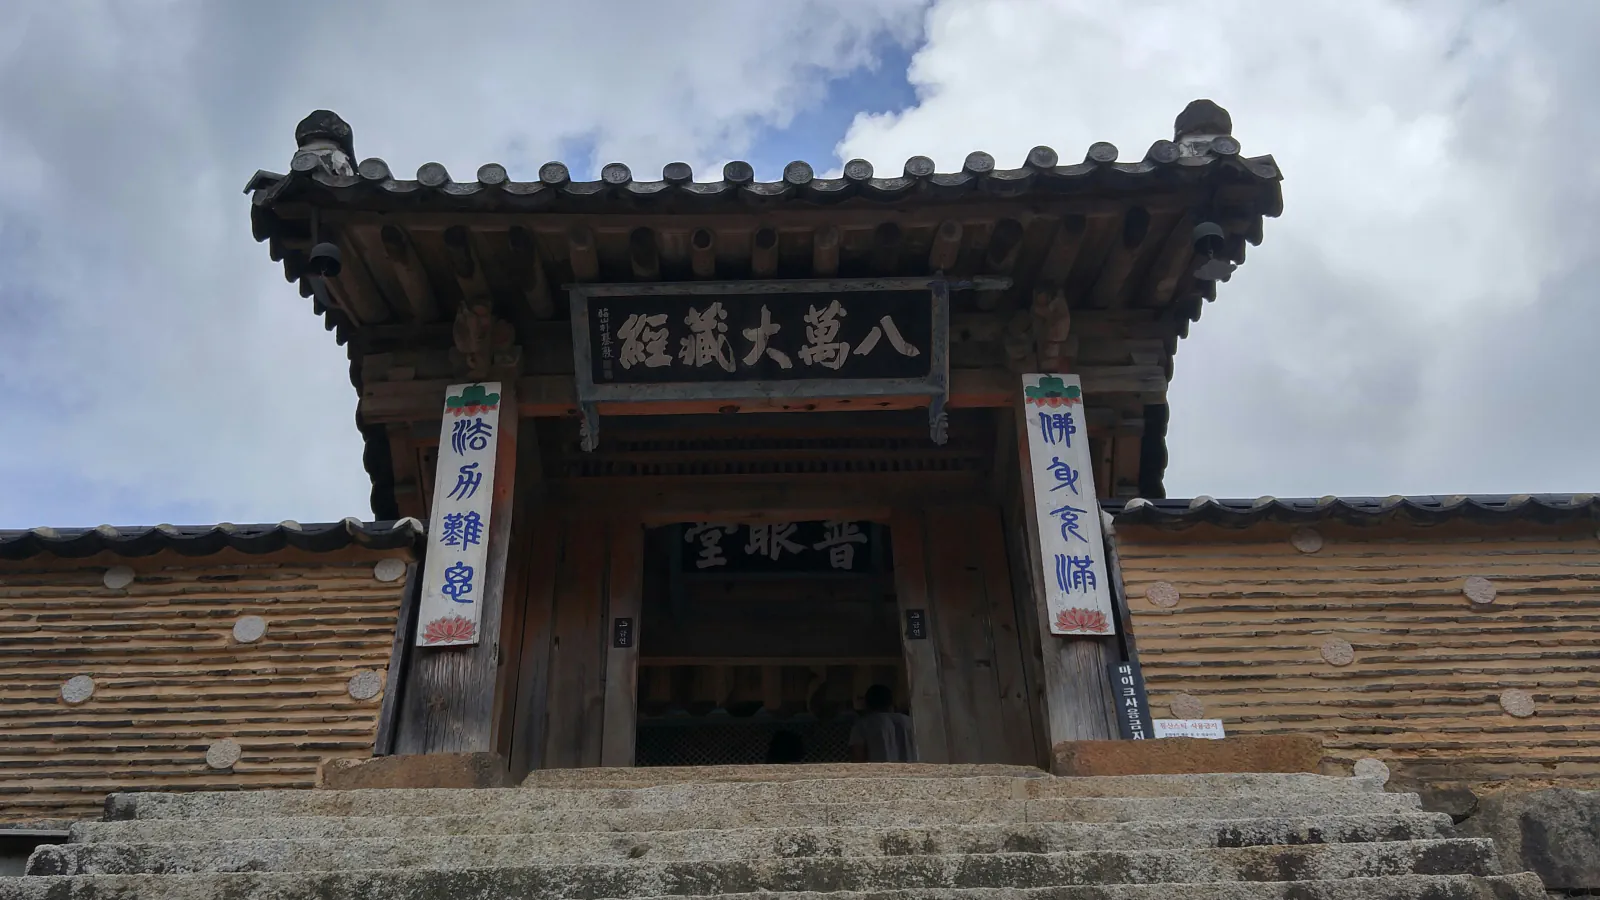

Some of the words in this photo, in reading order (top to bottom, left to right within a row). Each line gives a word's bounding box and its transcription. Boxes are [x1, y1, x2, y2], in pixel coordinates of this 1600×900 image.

[616, 299, 921, 373] 八萬大藏經
[1191, 722, 1218, 730] 사용금지
